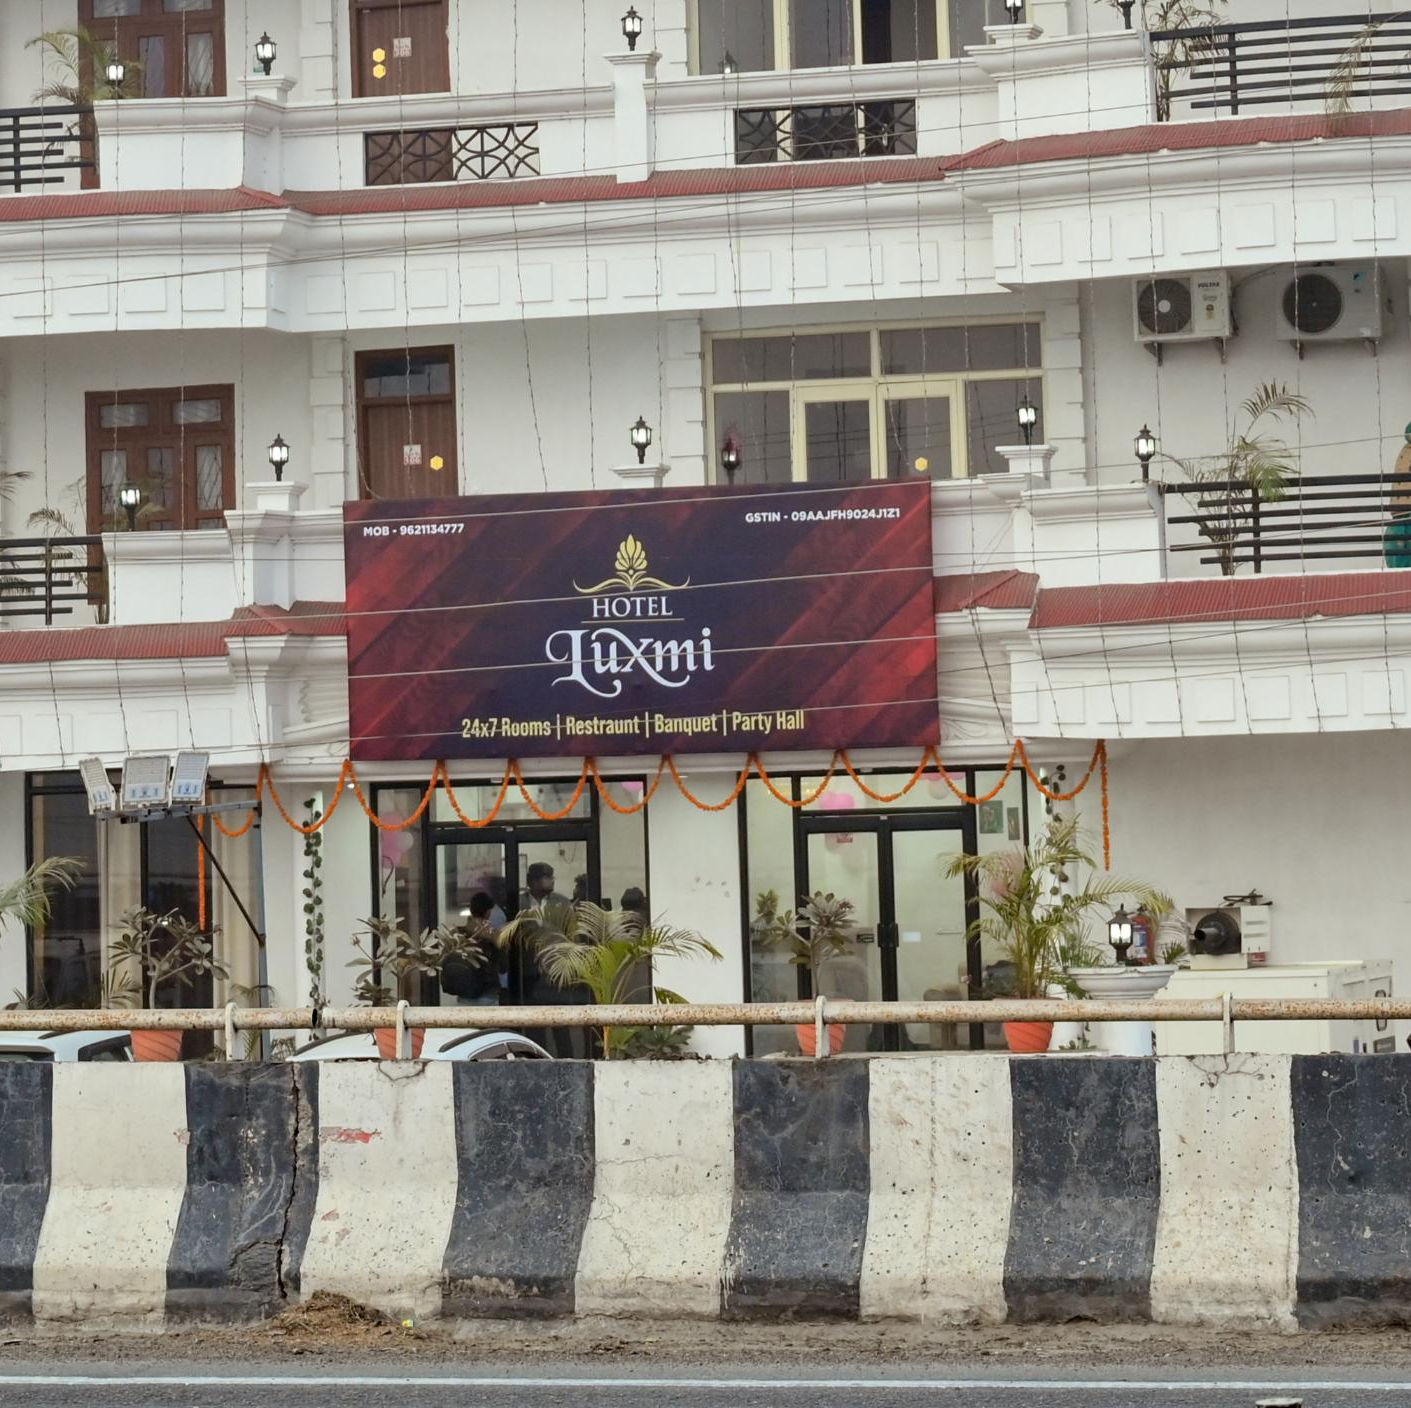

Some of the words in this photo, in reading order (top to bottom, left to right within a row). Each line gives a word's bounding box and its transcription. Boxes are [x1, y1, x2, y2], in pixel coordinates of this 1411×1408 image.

[745, 512, 781, 523] GSTIN
[363, 526, 390, 537] MOB
[399, 523, 465, 535] 9621134777
[592, 596, 673, 618] HOTEL
[545, 627, 716, 698] Luxmi
[462, 718, 498, 738] 24x7
[502, 718, 551, 736] Rooms
[566, 715, 640, 735] Restraunt
[654, 713, 718, 736] Banquet
[732, 712, 772, 734] Party
[777, 709, 804, 730] Hall
